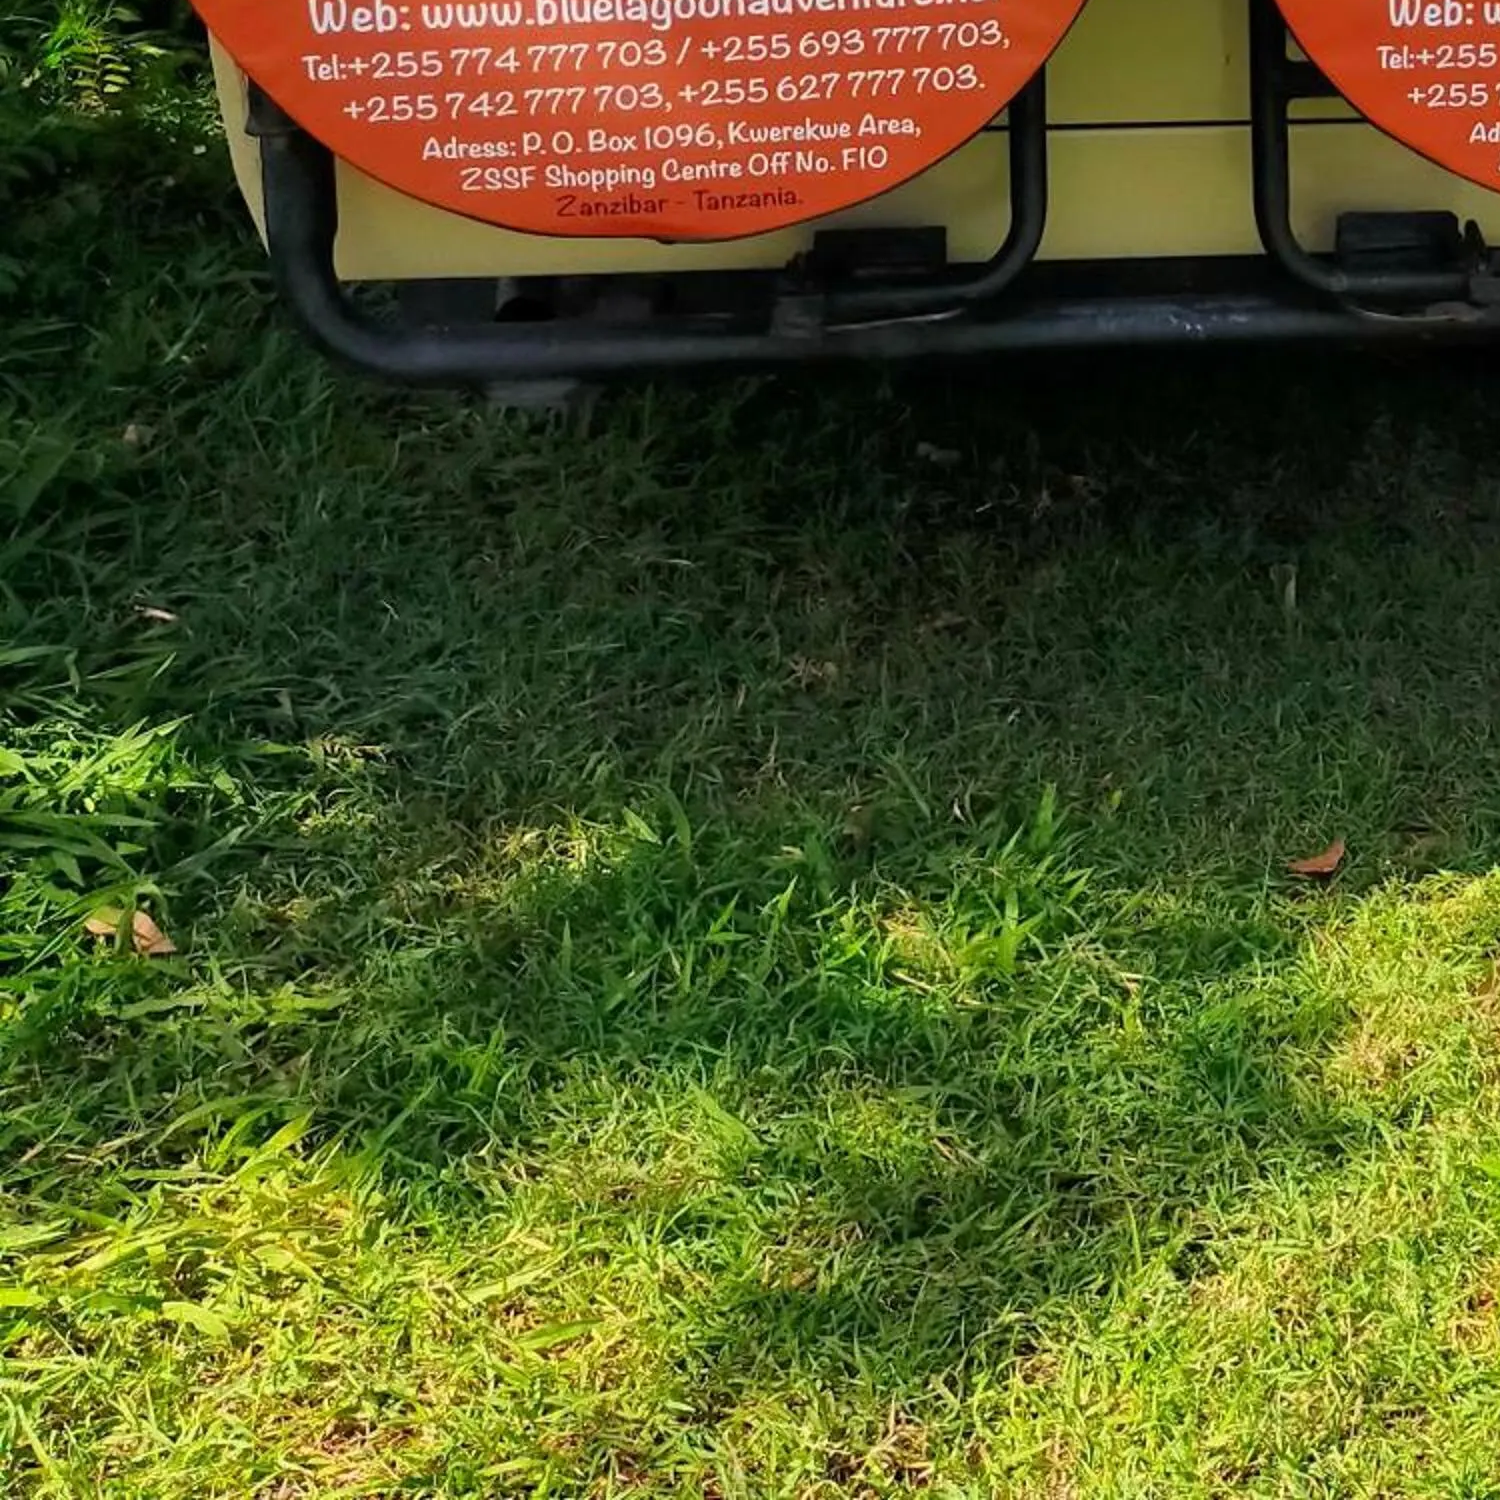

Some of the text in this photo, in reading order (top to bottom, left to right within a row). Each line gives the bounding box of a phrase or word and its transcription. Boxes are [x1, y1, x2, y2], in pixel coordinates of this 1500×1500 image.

[450, 47, 521, 76] 774
[527, 43, 589, 73] 777
[596, 39, 667, 69] 703
[675, 37, 691, 65] /
[701, 33, 791, 62] +255
[799, 29, 865, 58] 693
[872, 23, 931, 53] 777
[937, 19, 1011, 50] 703,
[343, 63, 985, 122] +255 742 777 703, +255 627 777 703.
[1407, 83, 1489, 108] +255
[422, 112, 921, 161] Adress: P. O. Box 1096, Kwerekwe Area,
[460, 166, 537, 191] ZSSF
[546, 164, 656, 192] Shopping
[662, 157, 742, 182] Centre
[749, 150, 789, 176] Off
[796, 149, 836, 174] No.
[556, 193, 665, 218] Zanzibar
[694, 186, 804, 212] Tanzania.
